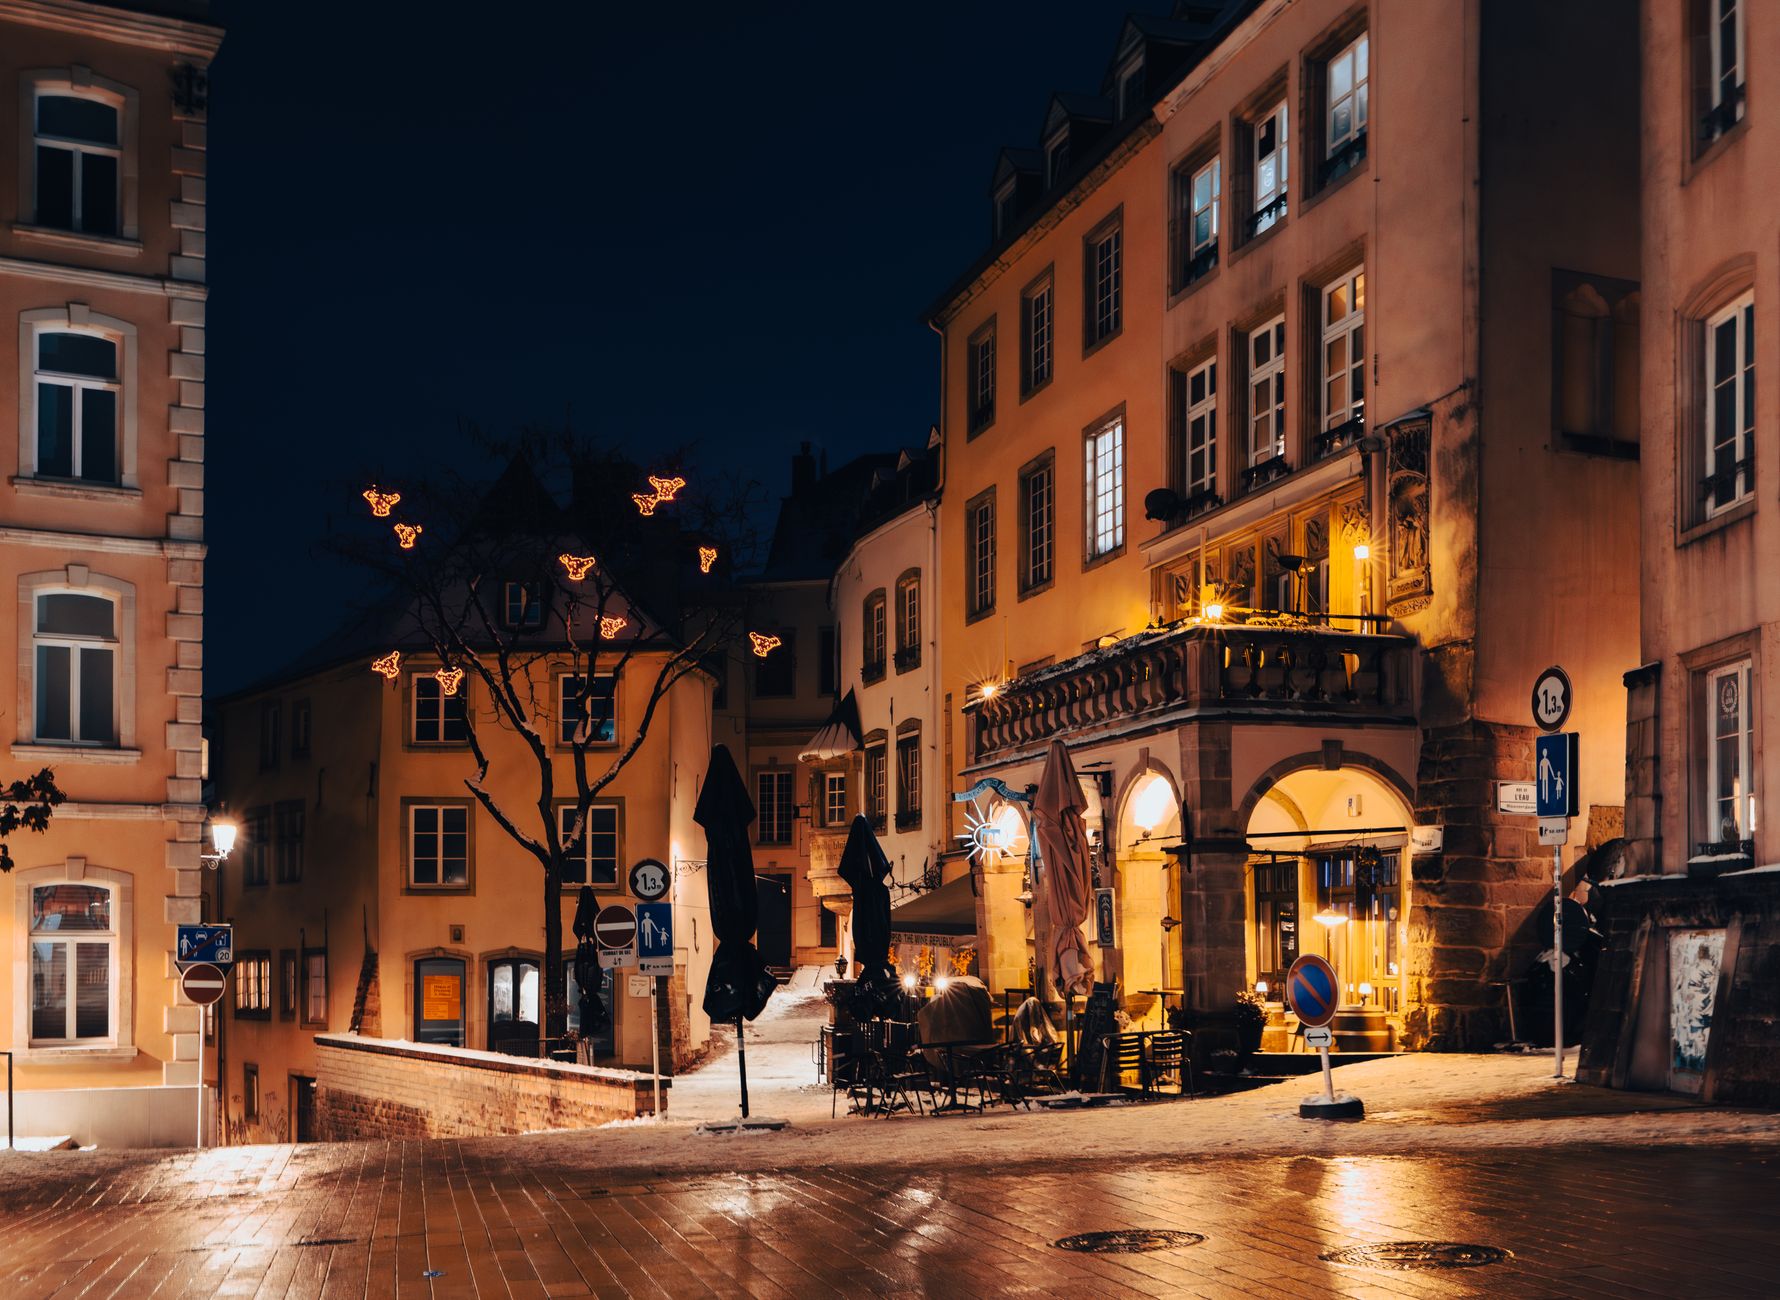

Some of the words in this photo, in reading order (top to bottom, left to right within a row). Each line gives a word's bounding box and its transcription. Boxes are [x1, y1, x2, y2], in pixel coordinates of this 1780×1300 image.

[904, 933, 914, 944] THE
[914, 934, 928, 945] WINE
[929, 935, 955, 948] REPUBLIC
[219, 951, 230, 961] 20
